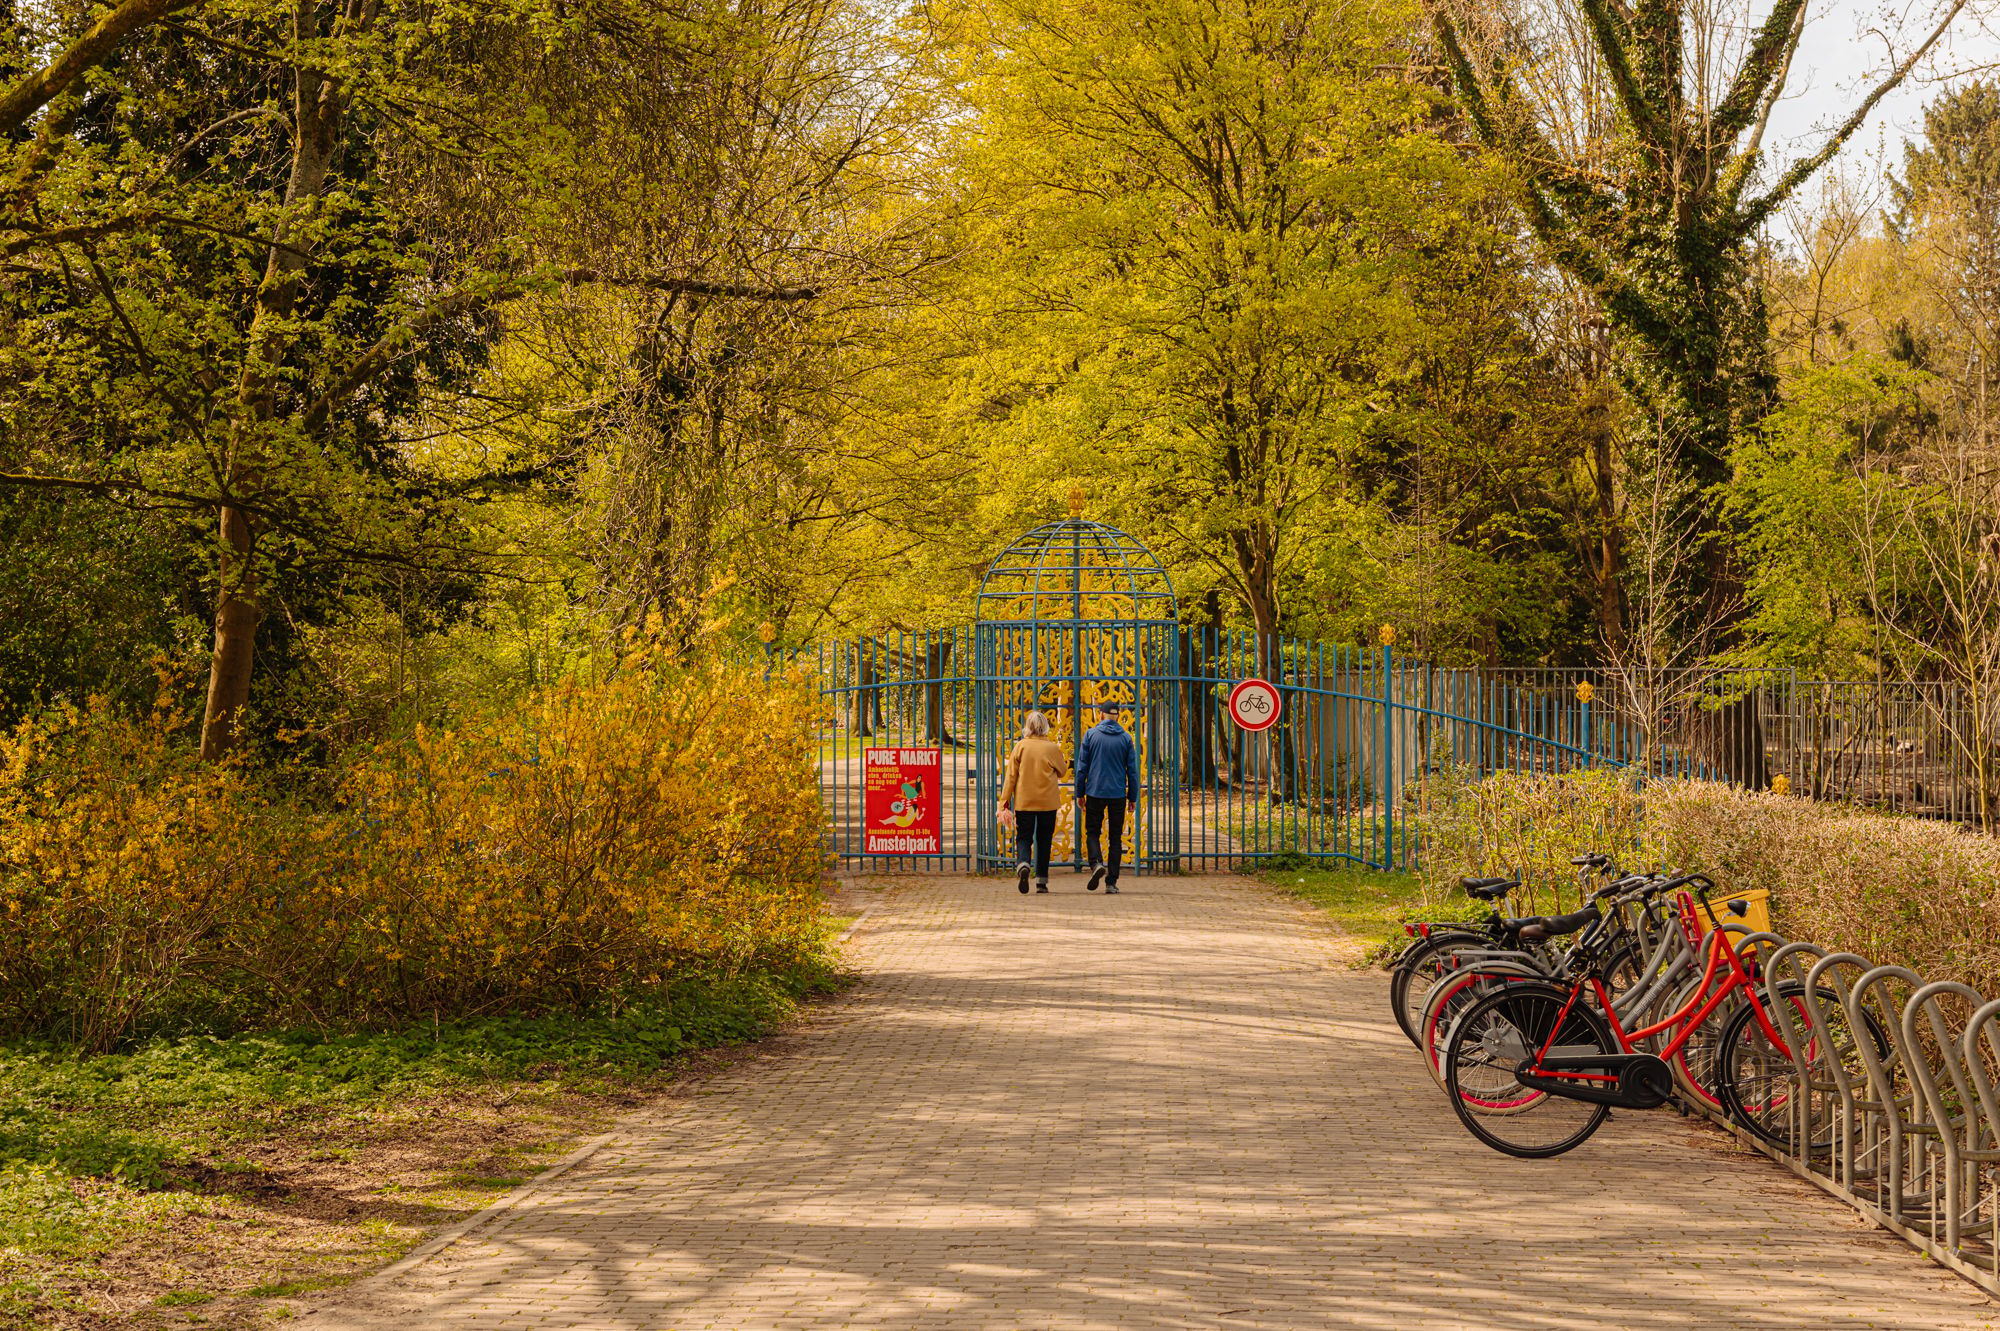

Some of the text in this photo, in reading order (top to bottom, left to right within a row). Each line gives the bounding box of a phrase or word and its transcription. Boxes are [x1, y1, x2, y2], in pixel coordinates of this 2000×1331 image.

[867, 750, 938, 766] PURE MARKT
[868, 835, 937, 854] Amstelpark
